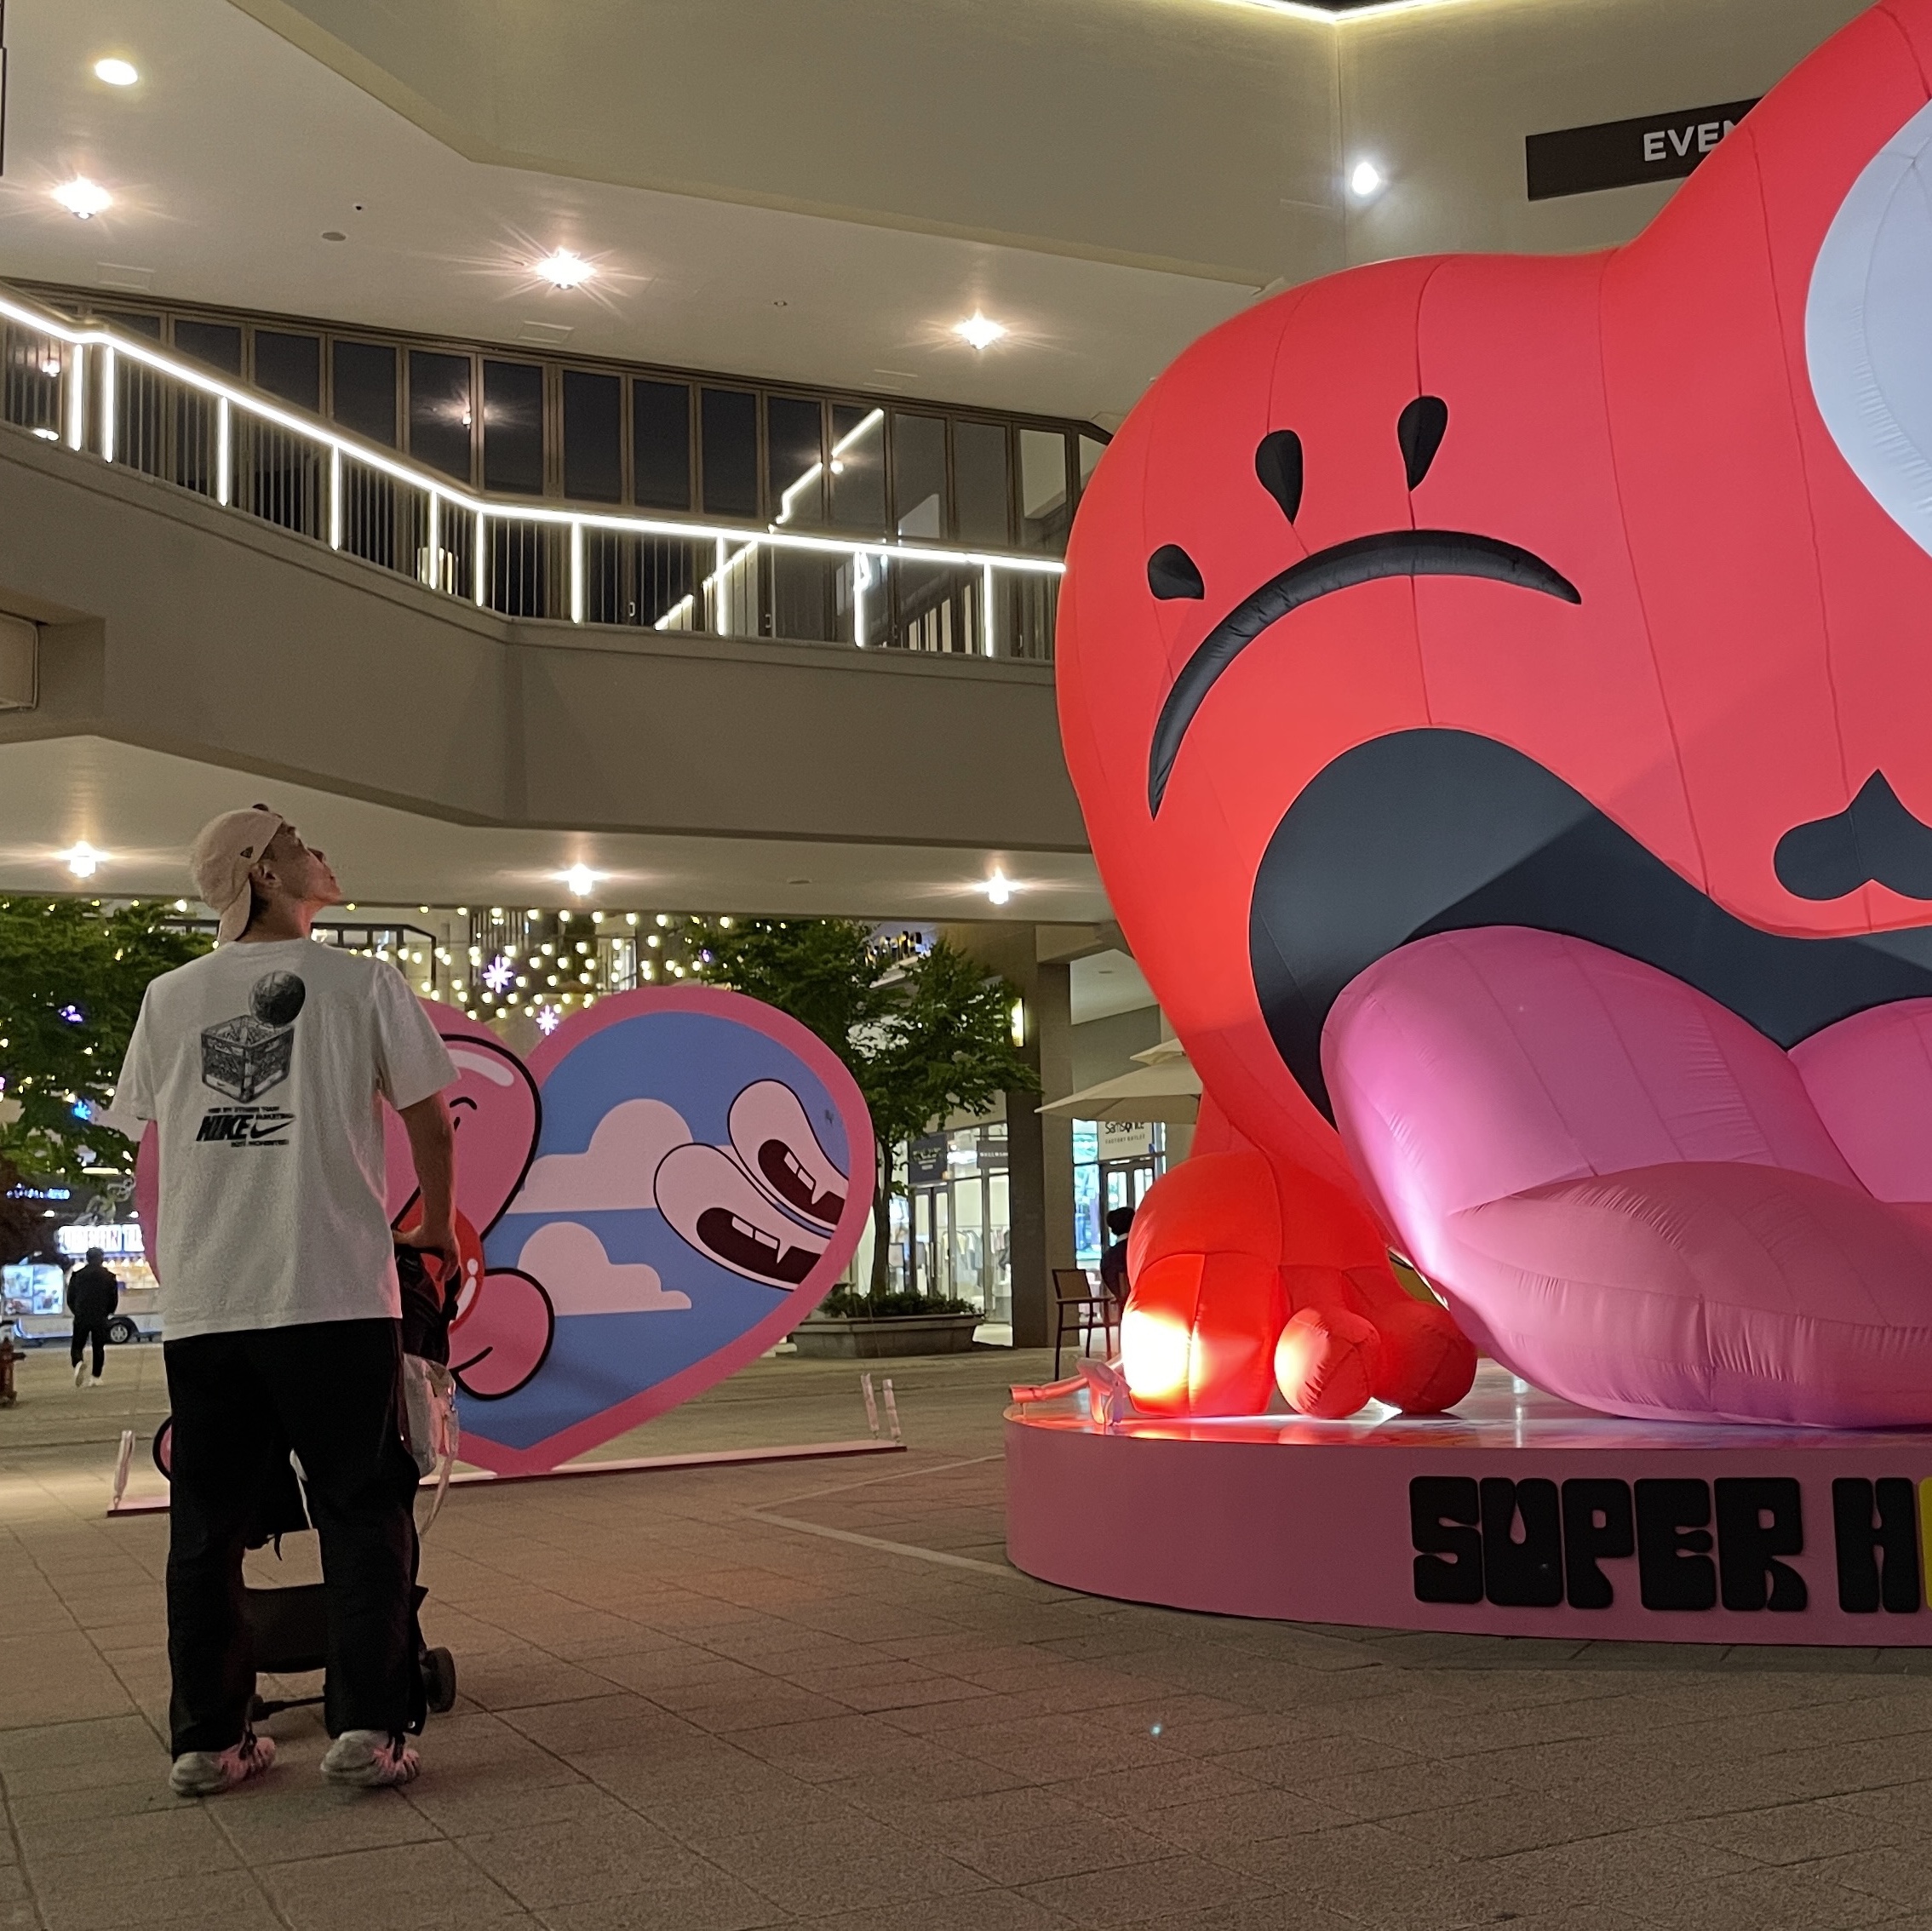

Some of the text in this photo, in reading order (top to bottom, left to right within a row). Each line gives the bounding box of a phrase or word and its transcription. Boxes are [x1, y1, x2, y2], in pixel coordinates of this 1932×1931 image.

[196, 1114, 255, 1142] NIKE
[1409, 1475, 1932, 1613] SUPER H
